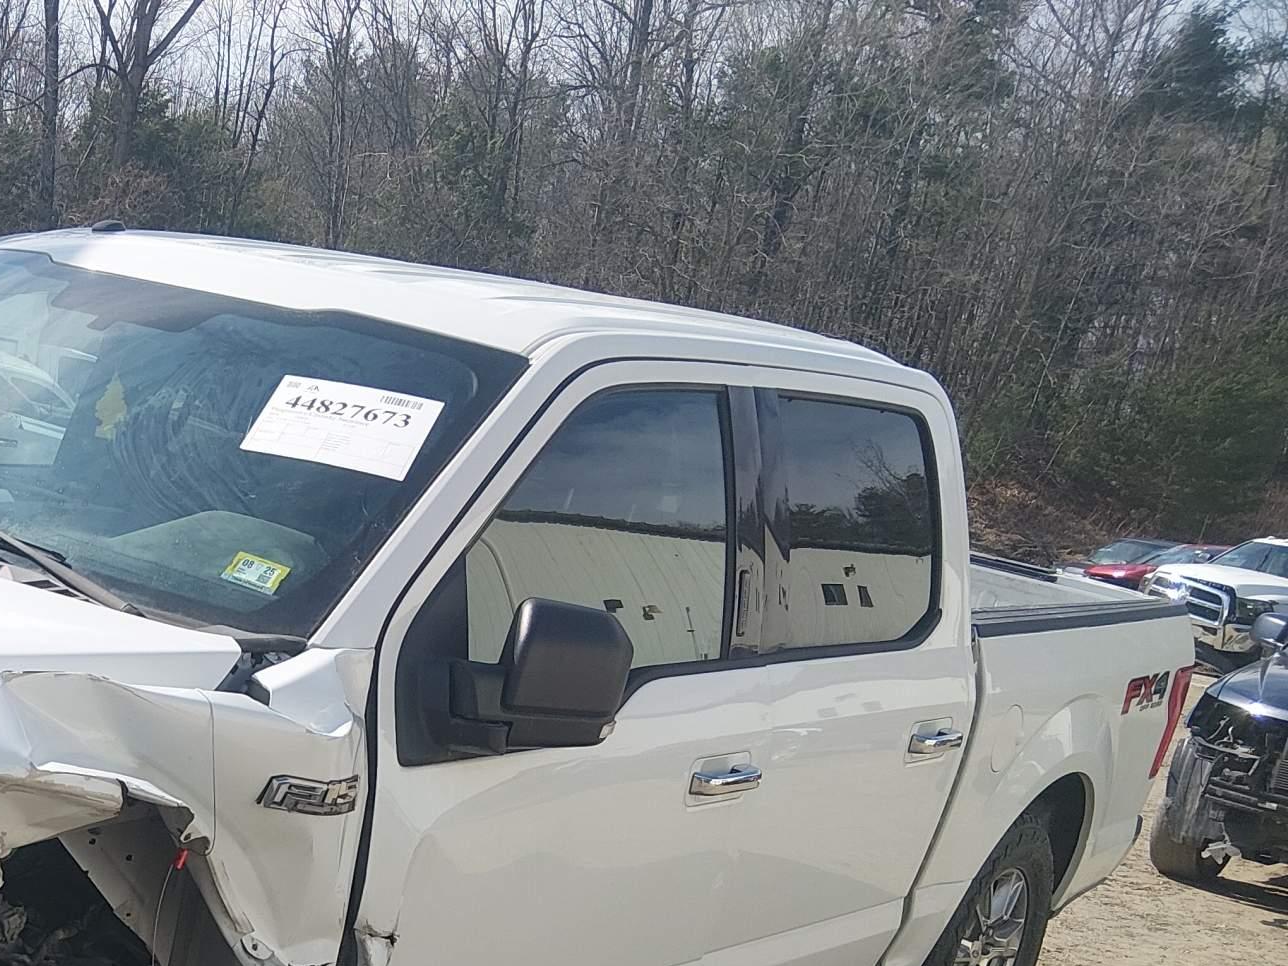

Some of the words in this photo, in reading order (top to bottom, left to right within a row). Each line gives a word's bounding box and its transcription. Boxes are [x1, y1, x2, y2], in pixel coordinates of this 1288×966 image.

[285, 395, 412, 428] 44827673
[263, 566, 277, 576] 25
[1121, 671, 1170, 715] FX4
